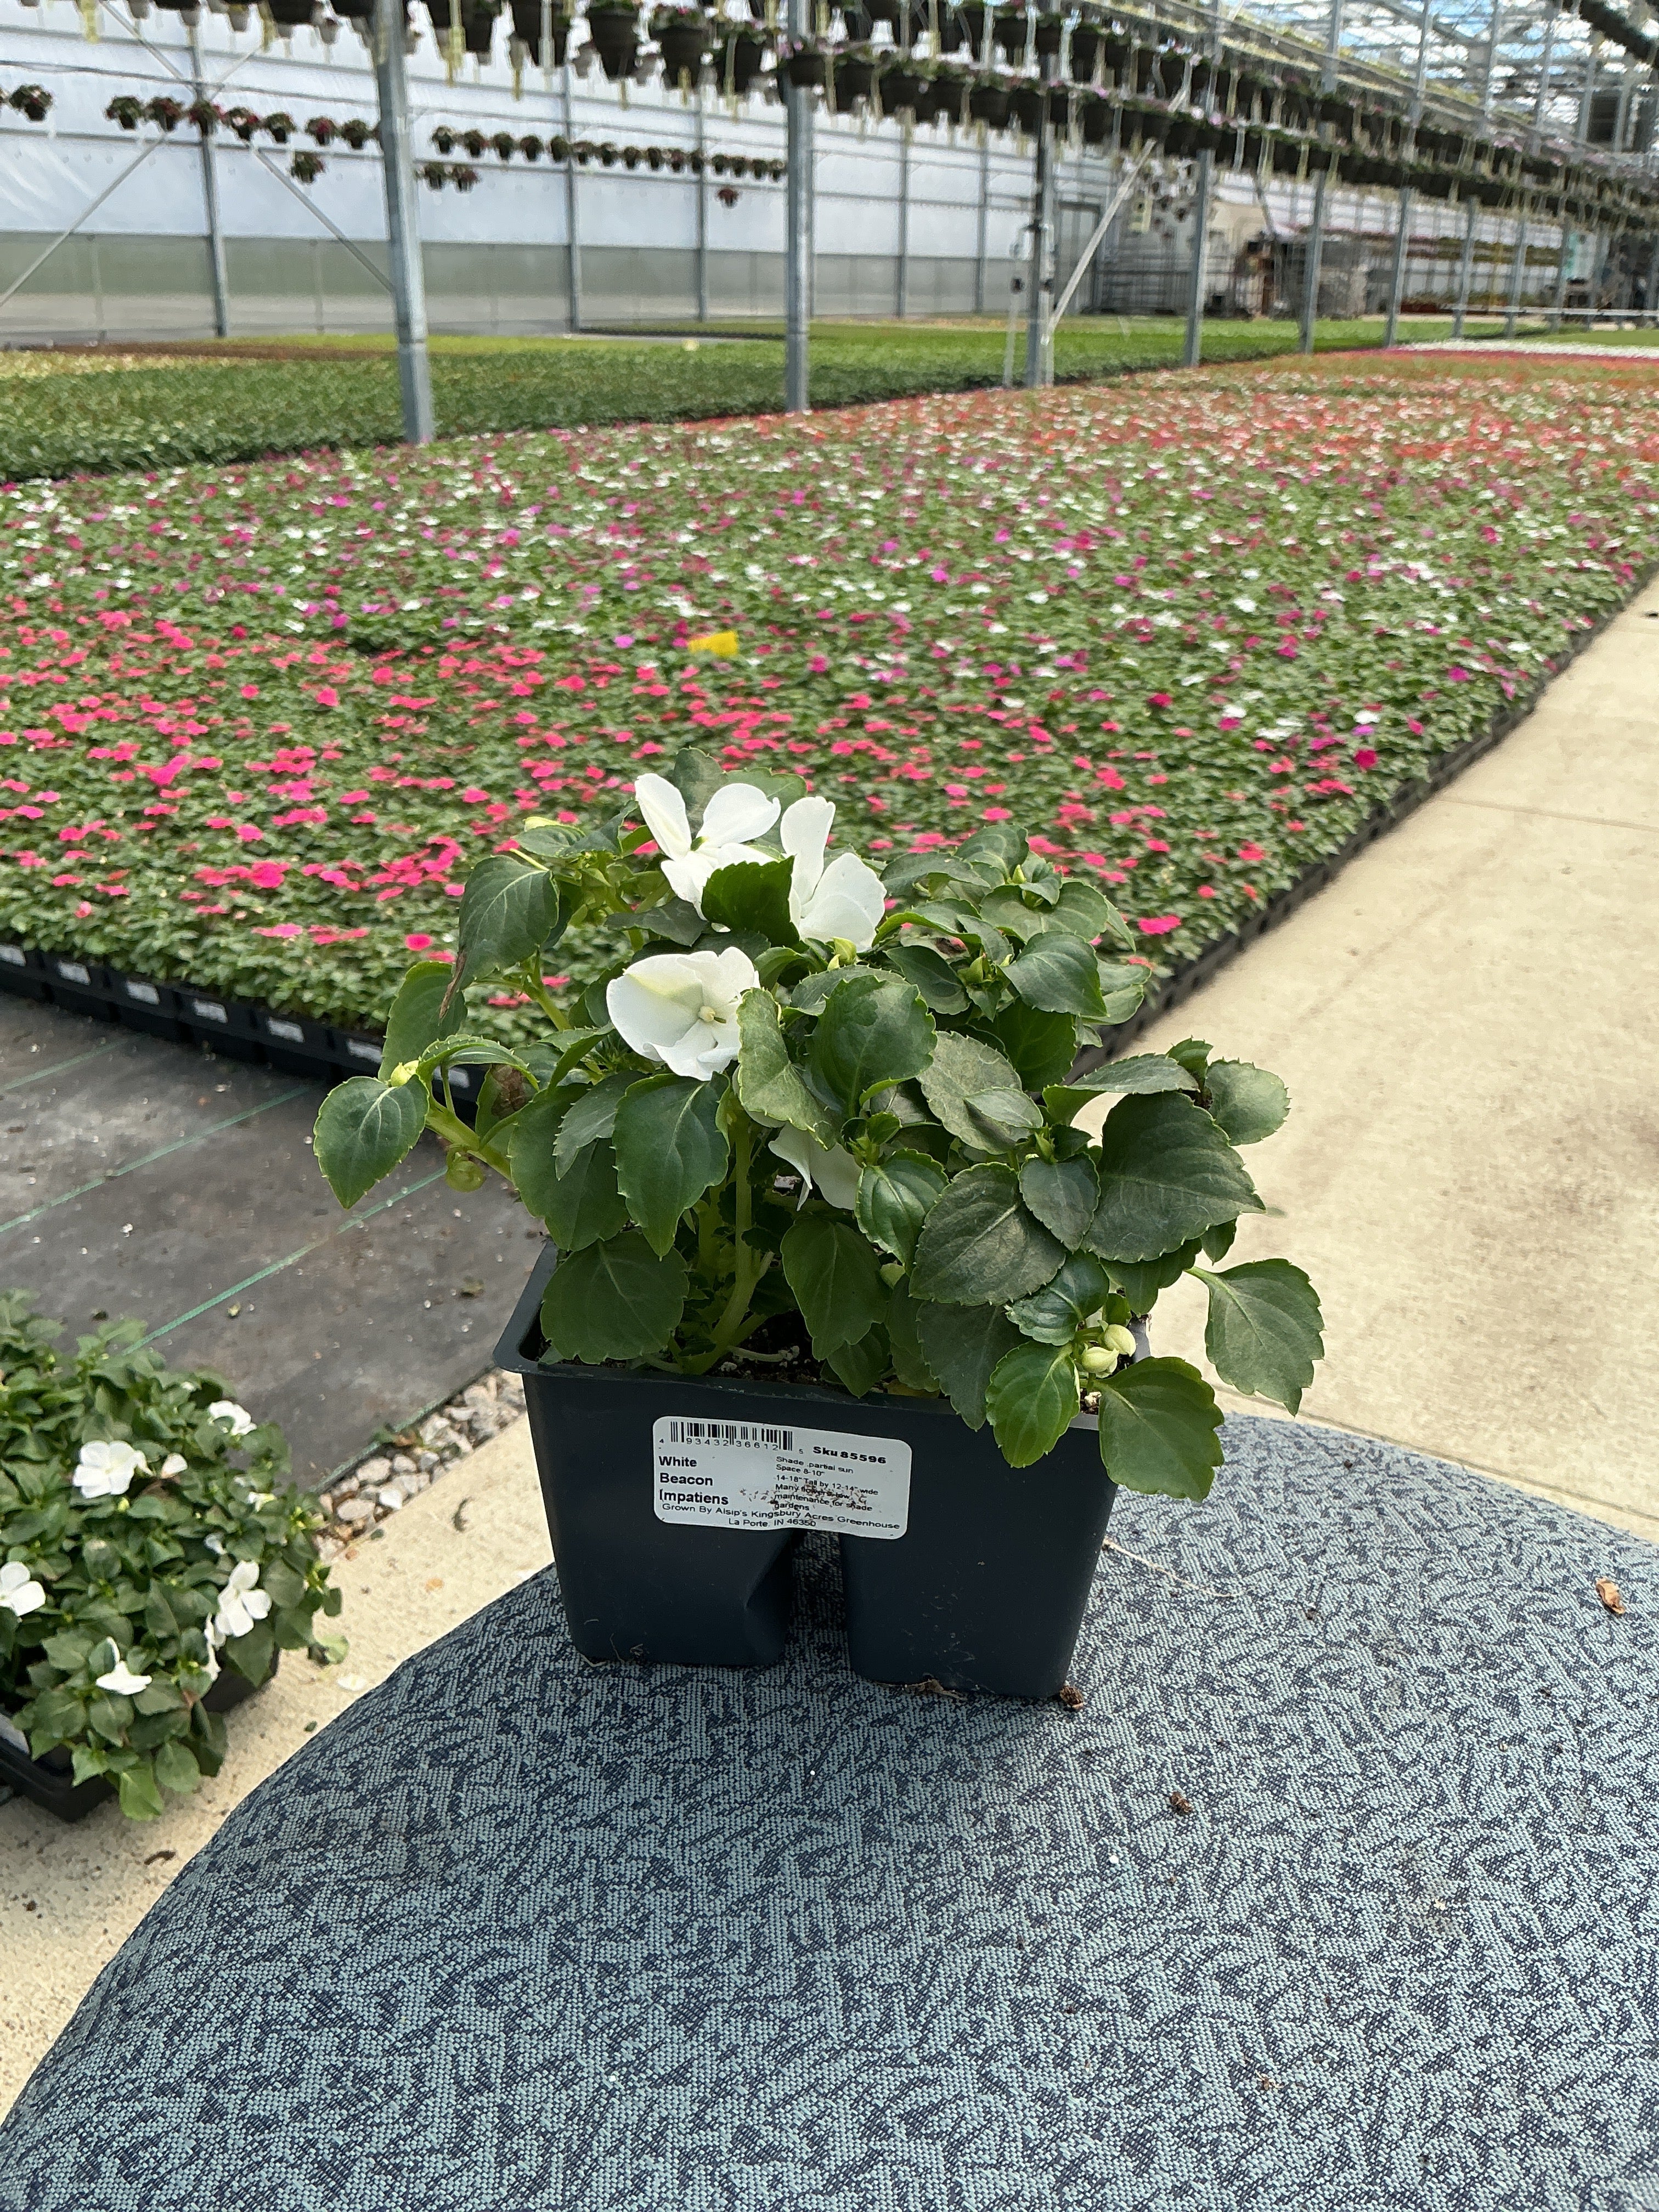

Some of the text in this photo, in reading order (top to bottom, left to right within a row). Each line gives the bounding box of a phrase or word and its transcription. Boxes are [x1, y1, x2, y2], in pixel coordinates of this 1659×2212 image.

[658, 1455, 697, 1467] White
[776, 1456, 804, 1466] Shade
[776, 1464, 802, 1474] Space
[660, 1472, 713, 1486] Beacon
[804, 1477, 817, 1486] Tall
[775, 1483, 799, 1493] Many
[659, 1488, 729, 1505] Impatiens
[774, 1502, 810, 1511] gardens
[662, 1503, 900, 1530] Grown By Alsip's Kingsbury Acres Greenhouse
[786, 1519, 816, 1527] 46350
